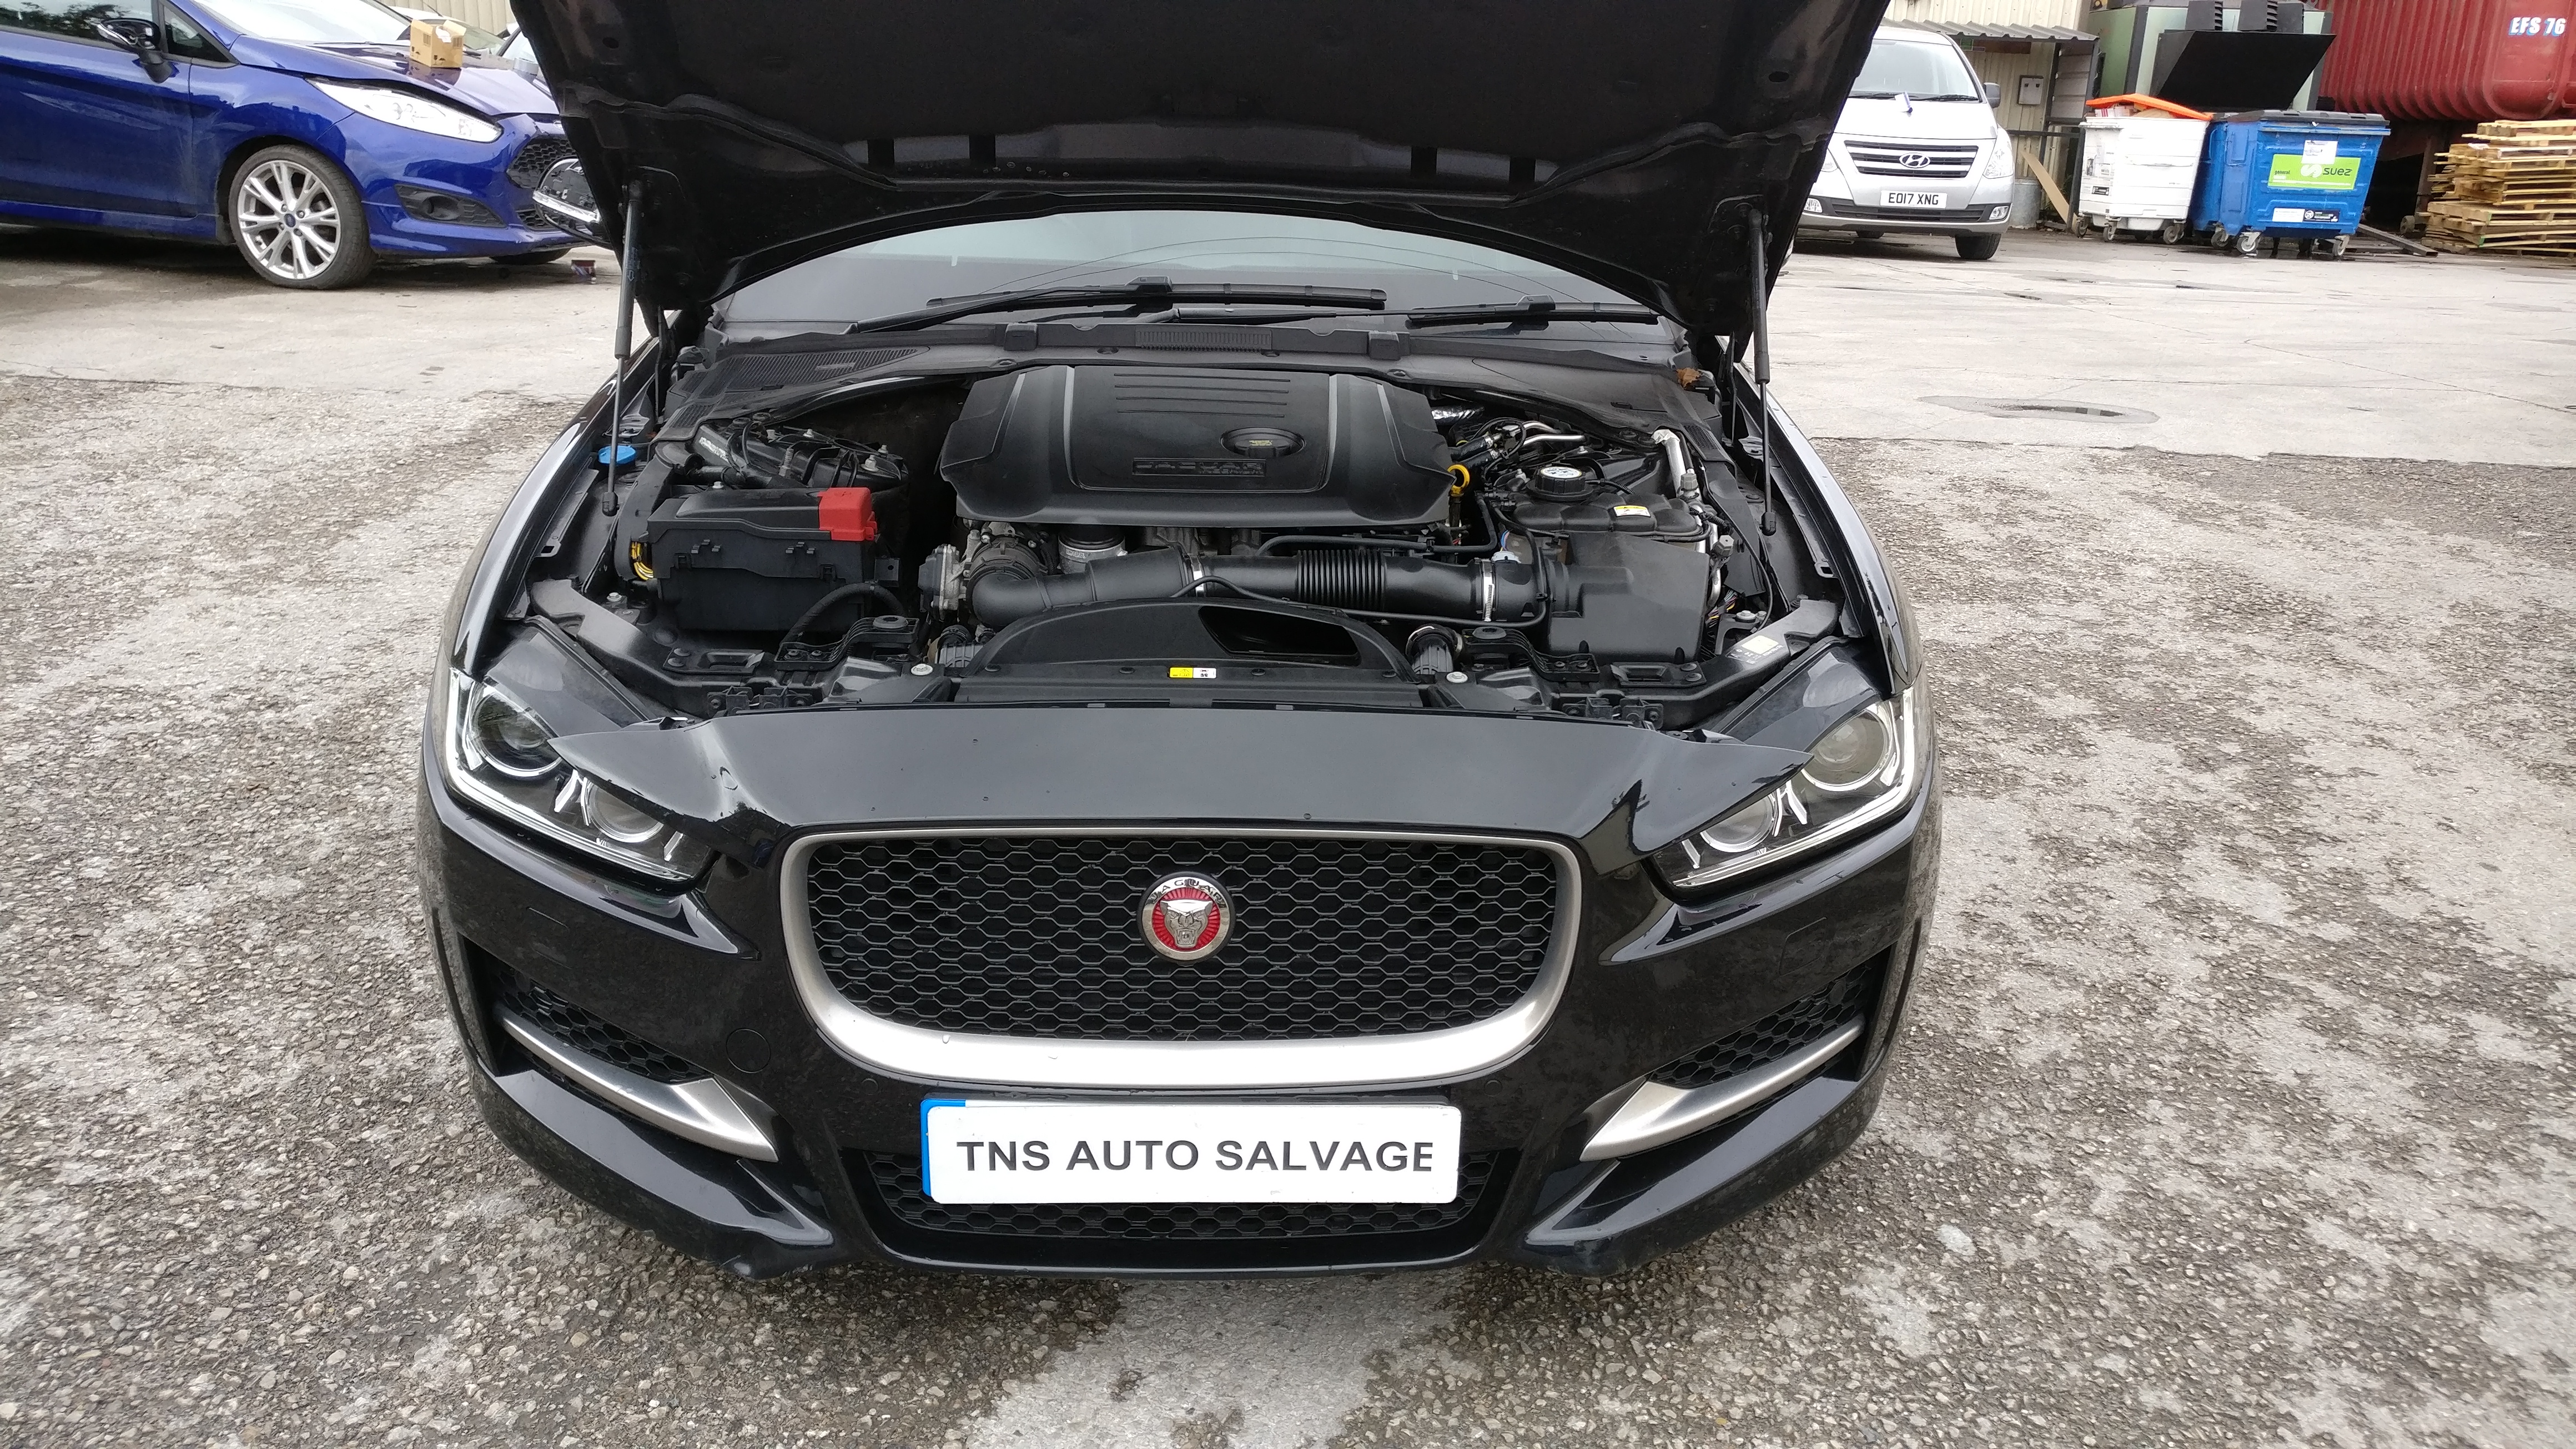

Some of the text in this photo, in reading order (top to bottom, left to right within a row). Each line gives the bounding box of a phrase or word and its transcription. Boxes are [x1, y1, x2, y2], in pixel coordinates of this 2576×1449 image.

[2508, 17, 2566, 36] EFS 76
[2322, 167, 2353, 176] suez
[1916, 193, 1939, 205] XNG
[1149, 878, 1227, 909] JAGUAR
[956, 1140, 1433, 1172] TNS AUTO SALVAGE
